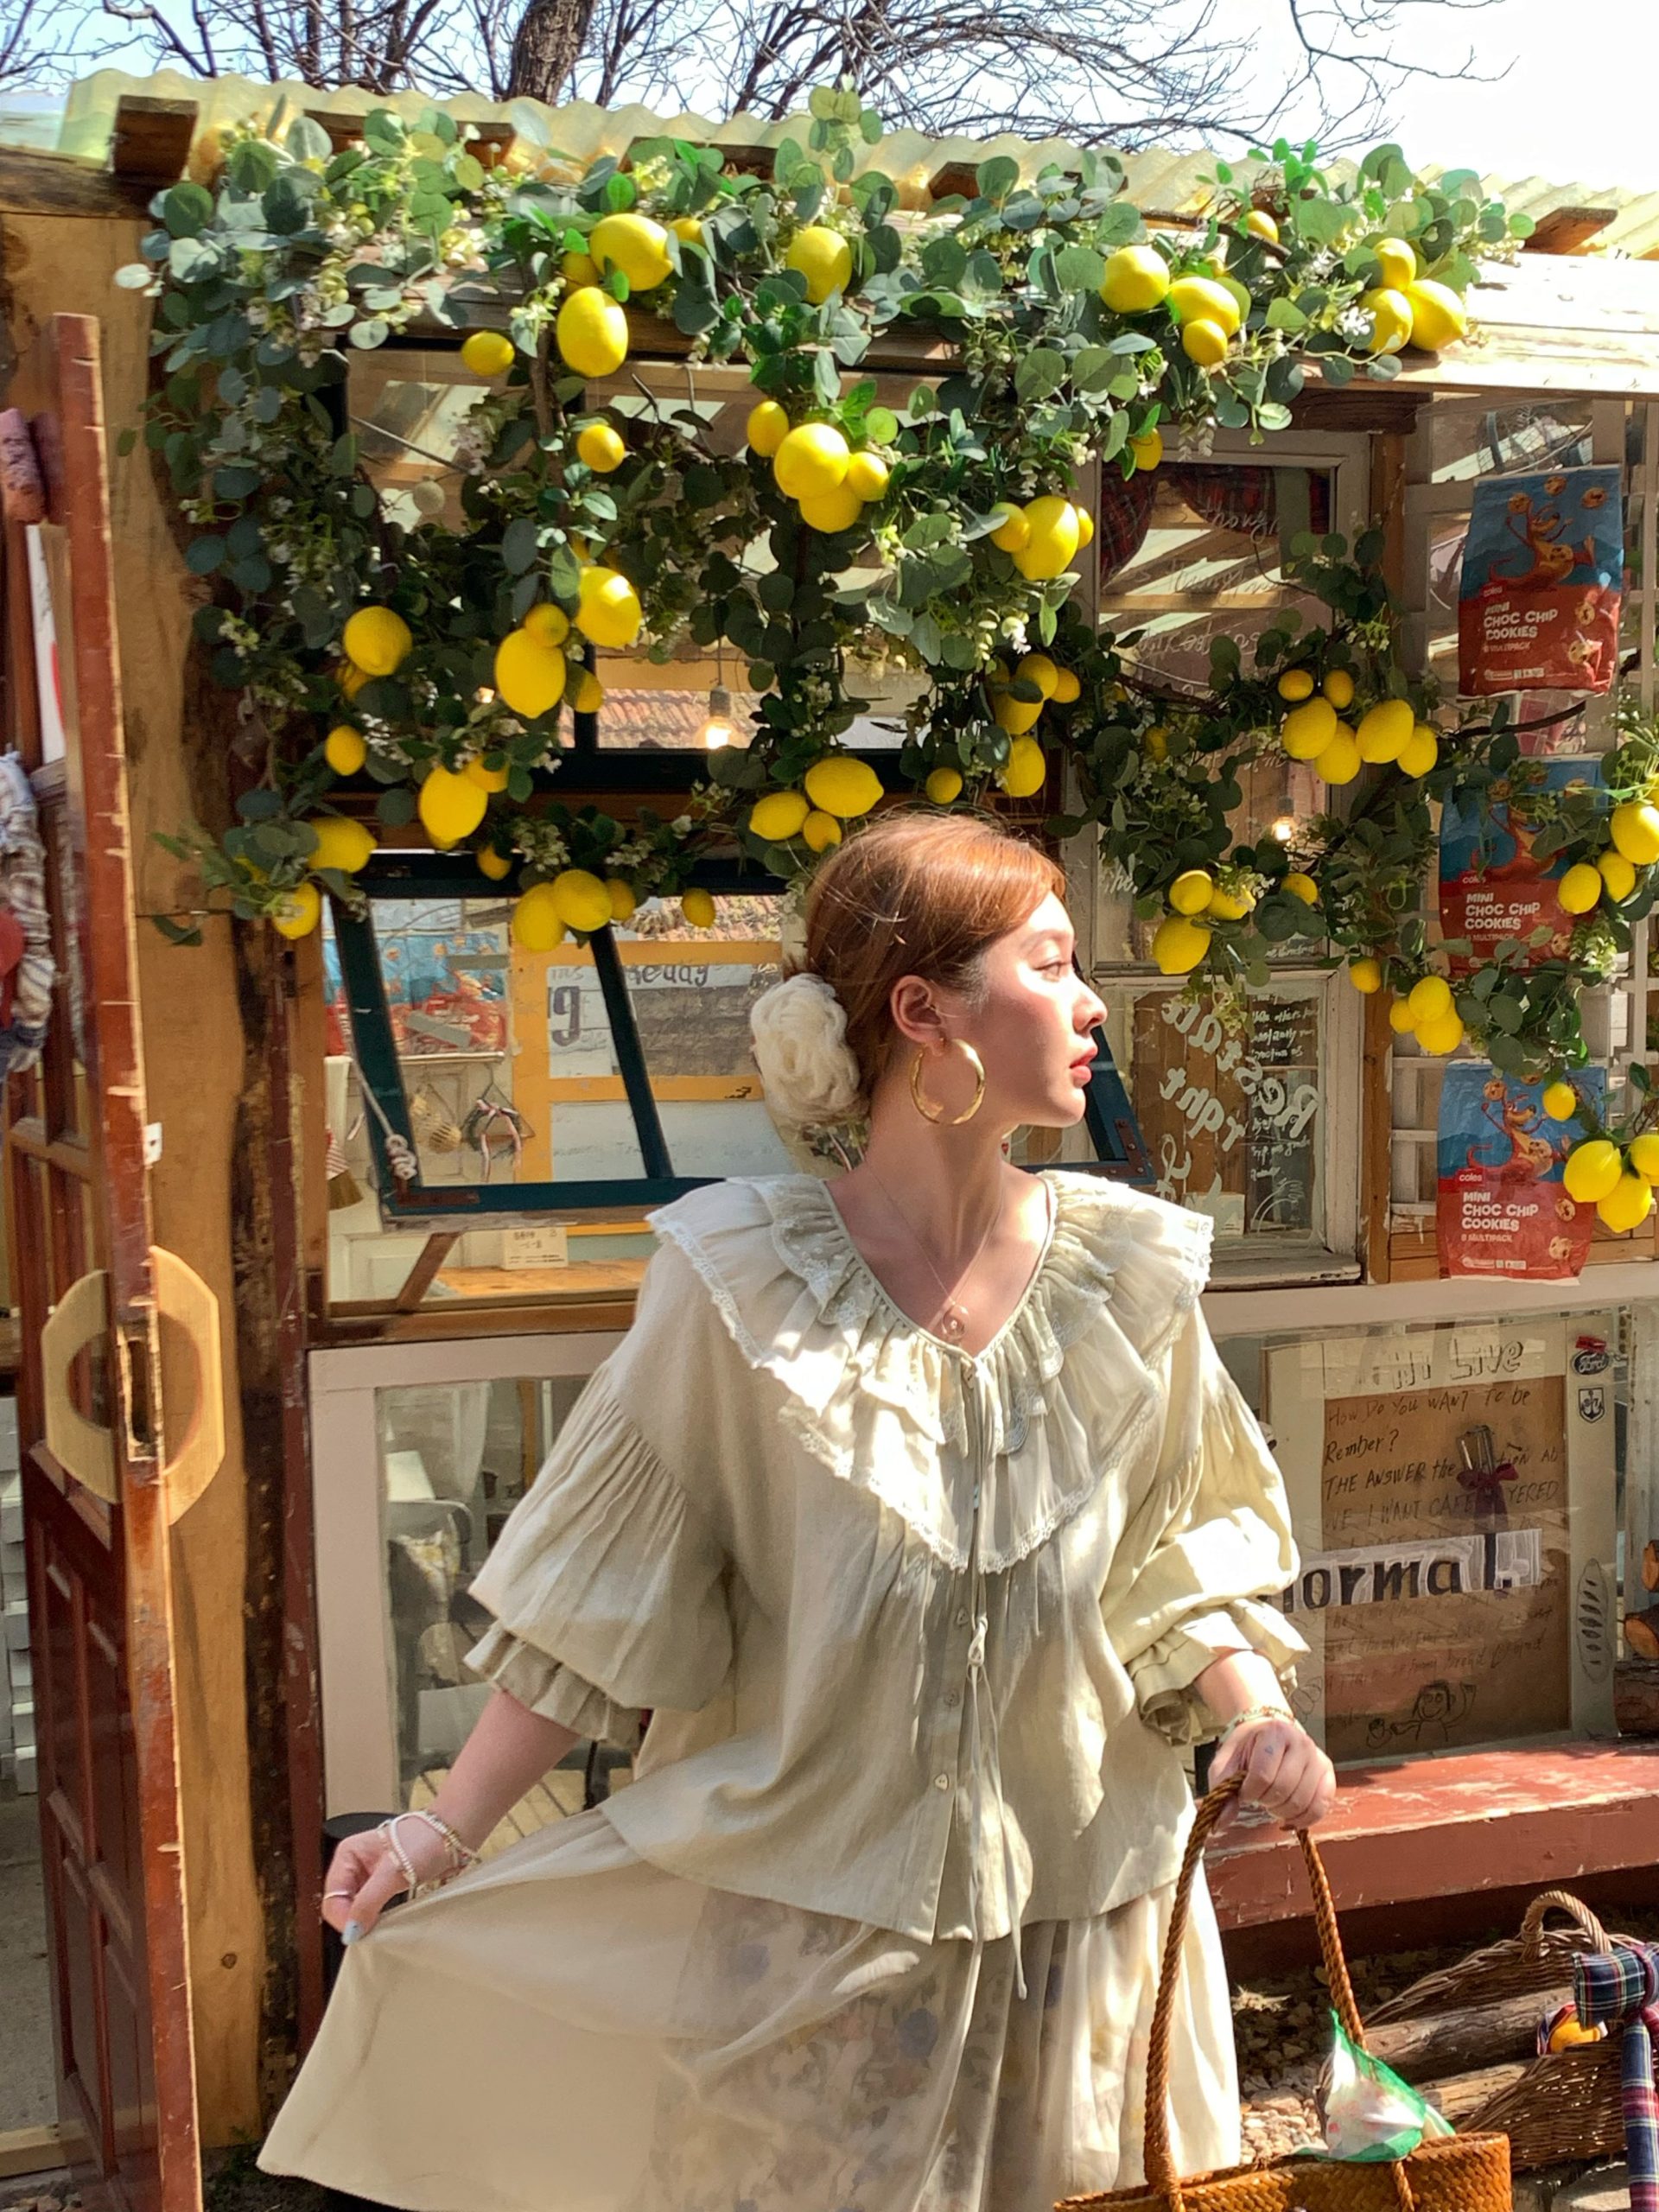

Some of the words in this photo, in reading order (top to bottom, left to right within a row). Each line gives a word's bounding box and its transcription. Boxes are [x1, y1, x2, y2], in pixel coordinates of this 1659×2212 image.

[1484, 612, 1521, 628] CHOC
[1524, 608, 1558, 623] CHIP
[1485, 626, 1538, 640] COOKIES
[1466, 893, 1494, 904] MINI
[1465, 903, 1504, 917] CHOC
[1509, 902, 1541, 916] CHIP
[1465, 916, 1522, 931] COOKIES
[1459, 1173, 1483, 1182] coles
[1463, 1192, 1491, 1203] MINI
[1462, 1203, 1503, 1217] CHOC
[1505, 1204, 1539, 1217] CHIP
[1461, 1217, 1520, 1232] COOKIES
[1325, 1472, 1358, 1502] THE
[1365, 1461, 1427, 1490] ANSWER
[1432, 1457, 1457, 1482] the
[1382, 1497, 1422, 1524] WANT
